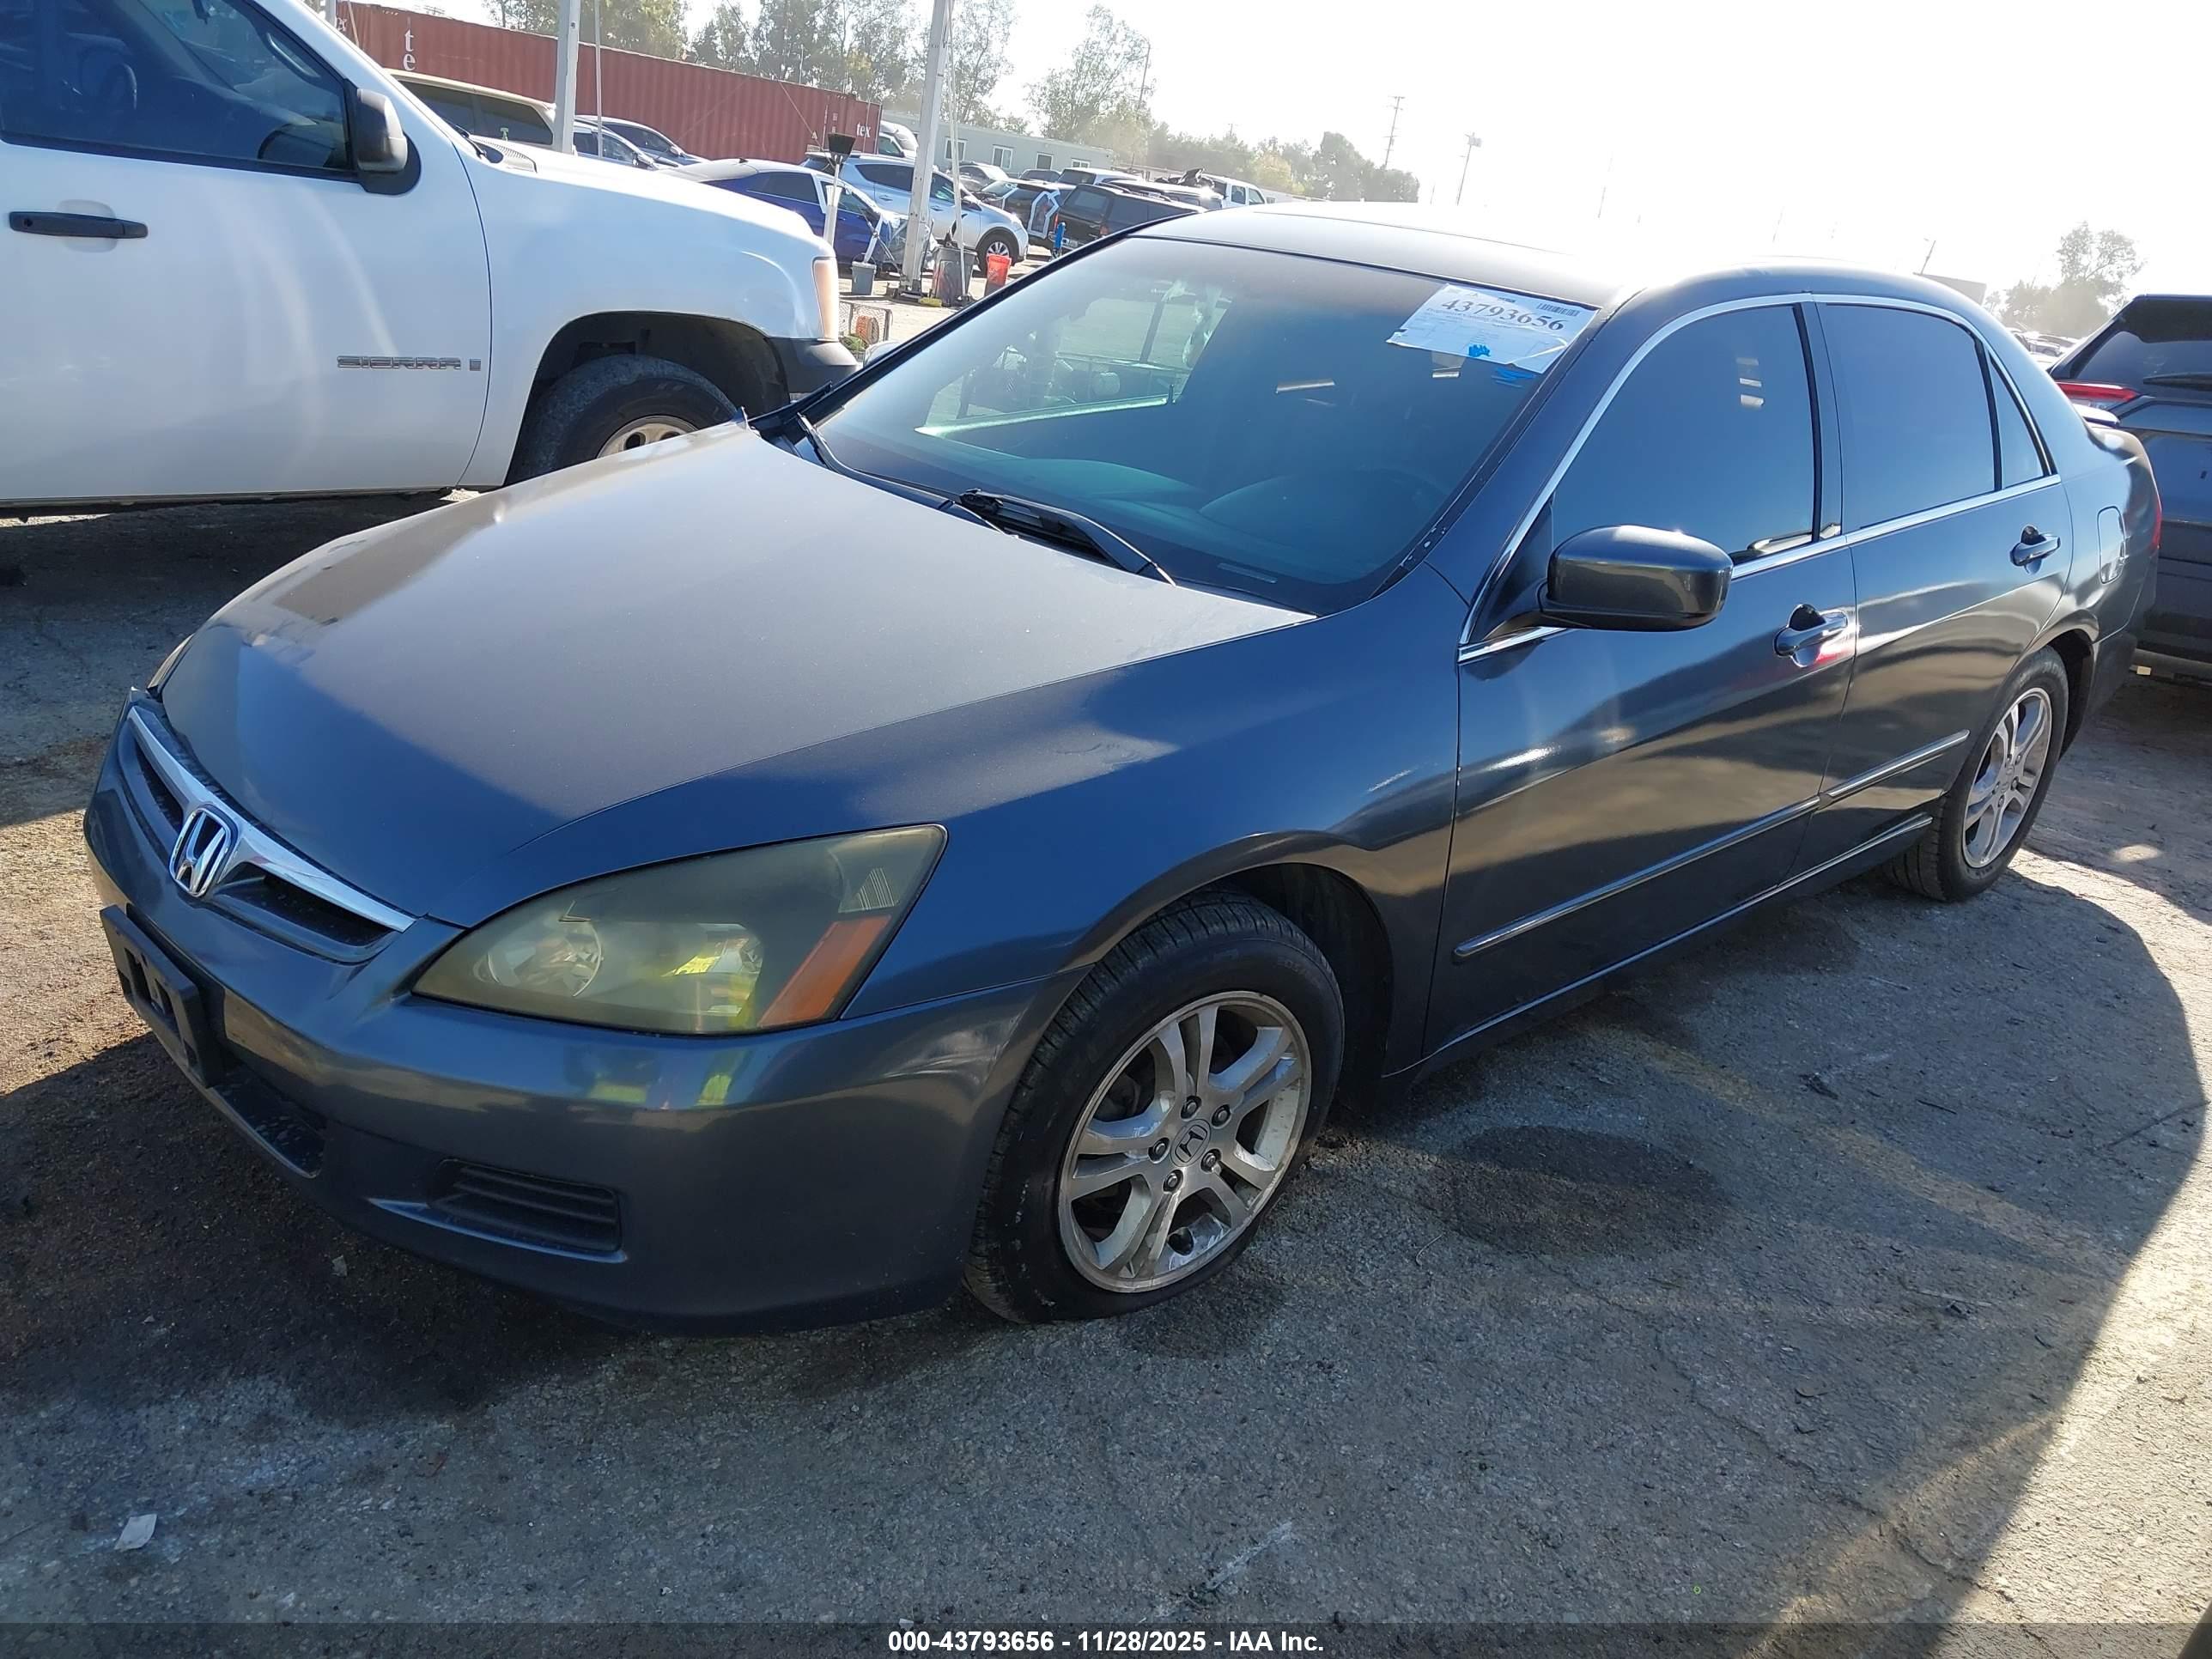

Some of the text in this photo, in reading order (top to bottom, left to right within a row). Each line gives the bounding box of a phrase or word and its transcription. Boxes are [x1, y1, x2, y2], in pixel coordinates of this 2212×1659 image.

[856, 122, 872, 138] tex
[1442, 298, 1570, 331] 43793656
[337, 355, 462, 370] SIERRA
